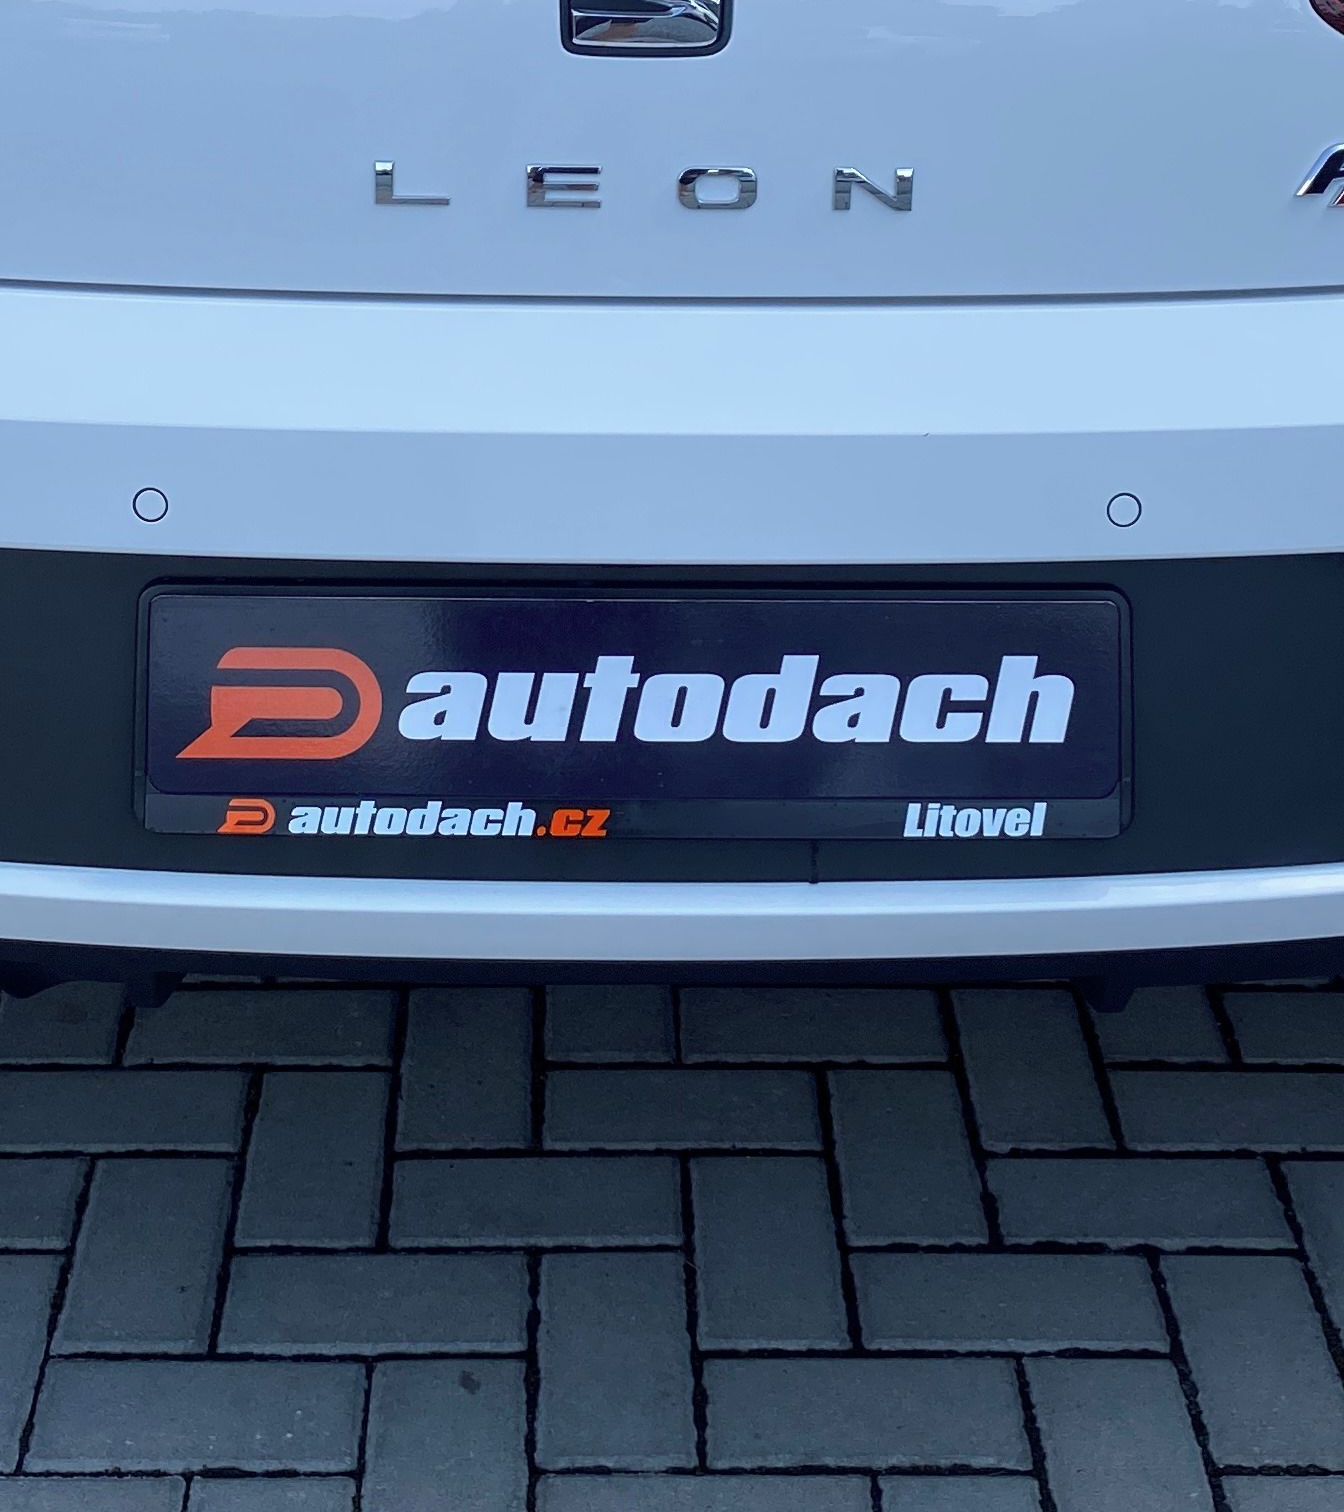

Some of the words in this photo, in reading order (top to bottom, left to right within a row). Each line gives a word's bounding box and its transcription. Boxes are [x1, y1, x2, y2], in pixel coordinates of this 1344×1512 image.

[373, 160, 915, 211] LEON
[398, 654, 1075, 744] autodach
[287, 800, 612, 837] autodach.cz
[903, 801, 1048, 838] Litovel
